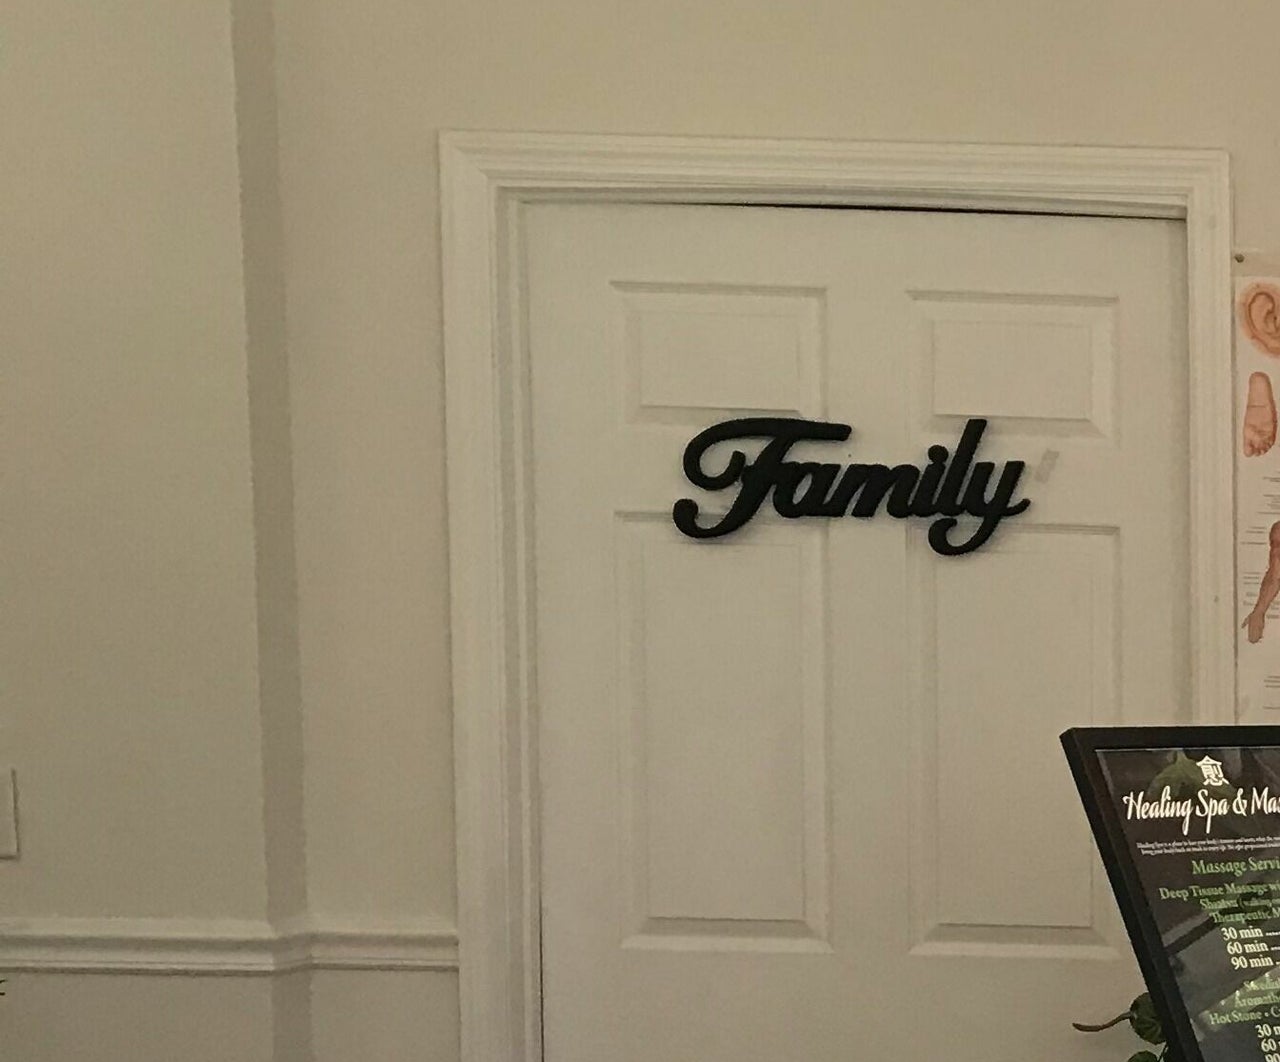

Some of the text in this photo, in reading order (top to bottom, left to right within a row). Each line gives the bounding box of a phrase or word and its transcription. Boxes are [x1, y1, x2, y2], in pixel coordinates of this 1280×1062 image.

[673, 417, 1031, 556] Family
[1122, 786, 1193, 836] Healing
[1195, 789, 1229, 834] Spa
[1232, 787, 1248, 817] &
[1191, 860, 1247, 877] Massage
[1159, 887, 1189, 901] Deep
[1189, 885, 1224, 897] Tissue
[1224, 883, 1268, 896] Massage
[1220, 927, 1238, 942] 30
[1239, 925, 1264, 939] min
[1227, 941, 1243, 955] 60
[1244, 940, 1269, 953] min
[1231, 955, 1248, 970] 90
[1249, 954, 1274, 967] min
[1209, 1013, 1231, 1025] Hot
[1231, 1011, 1262, 1023] Stone
[1255, 1024, 1272, 1039] 30
[1260, 1038, 1277, 1053] 60
